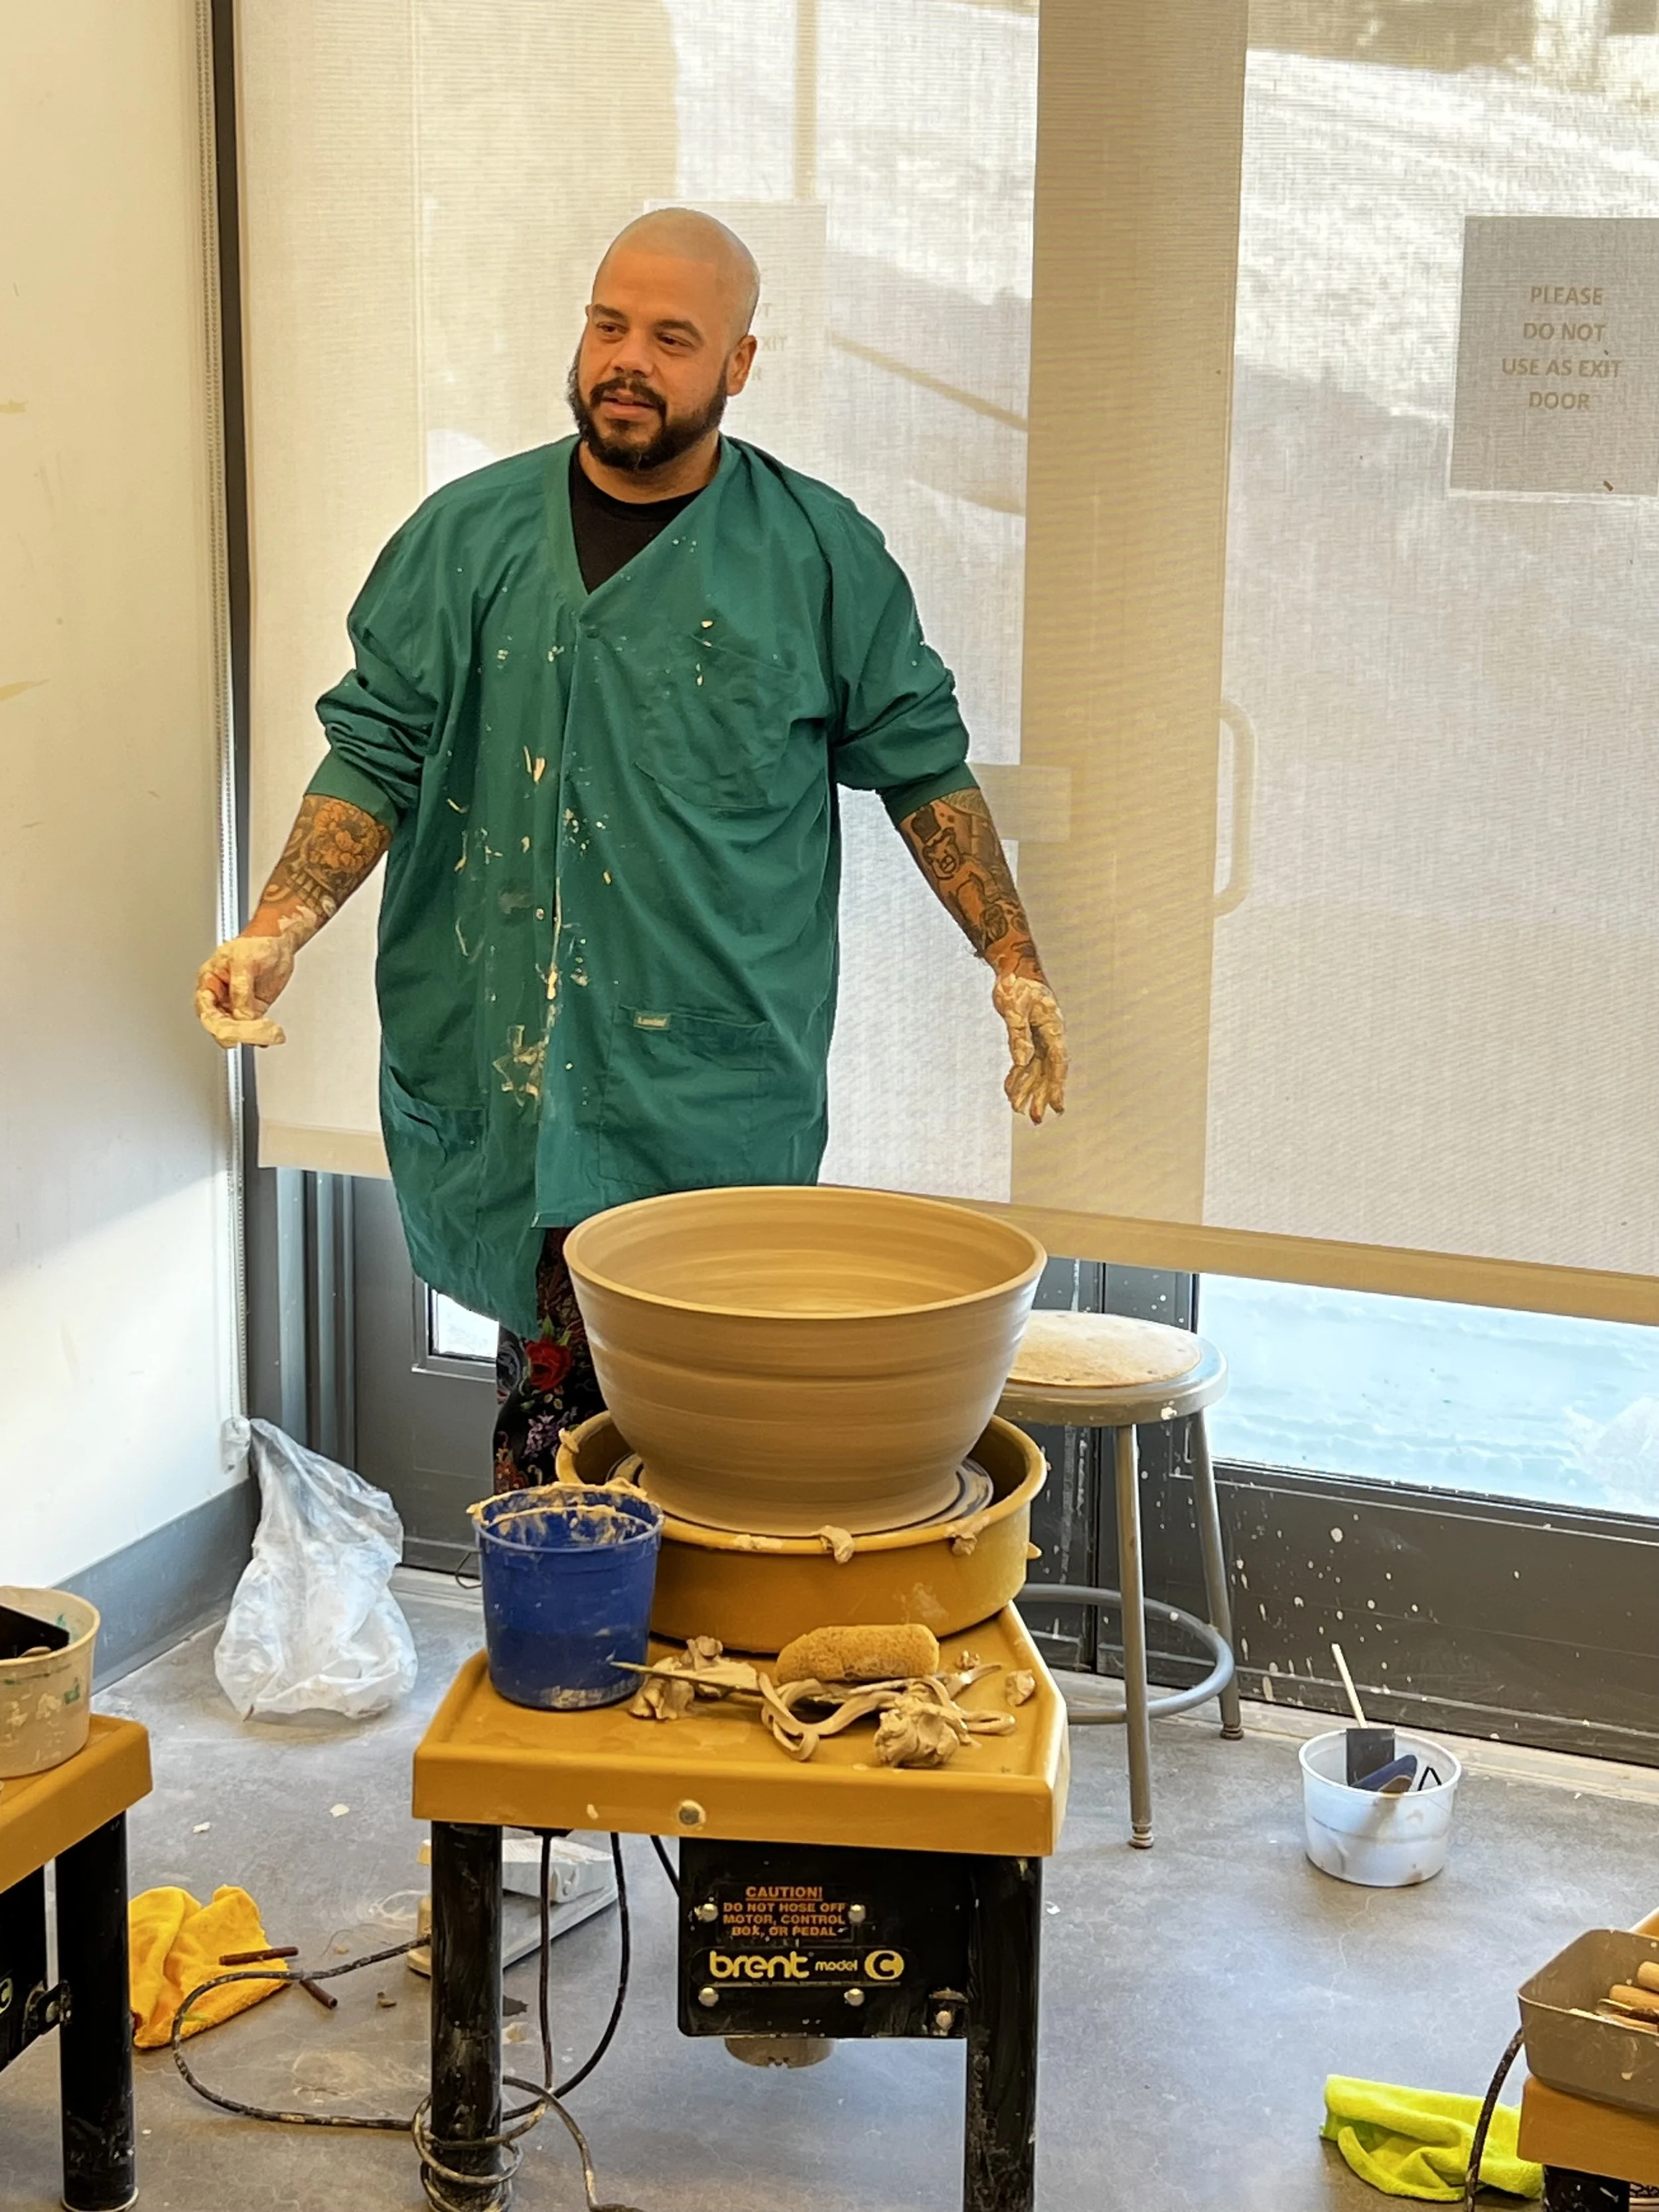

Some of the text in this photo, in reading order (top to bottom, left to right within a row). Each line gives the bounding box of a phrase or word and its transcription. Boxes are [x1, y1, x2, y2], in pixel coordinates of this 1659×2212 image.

[1531, 286, 1604, 306] PLEASE
[1524, 323, 1607, 342] DO NOT
[760, 335, 788, 352] XIT
[1502, 358, 1623, 378] USE AS EXIT
[1529, 392, 1591, 410] DOOR
[745, 1886, 823, 1899] CAUTION!
[723, 1902, 846, 1913] DO NOT HOSE OFF
[723, 1914, 845, 1925] MOTOR, CONTROL
[768, 1926, 788, 1937] OR
[792, 1926, 837, 1937] PEDAL
[709, 1951, 810, 1978] brent
[815, 1960, 858, 1971] model
